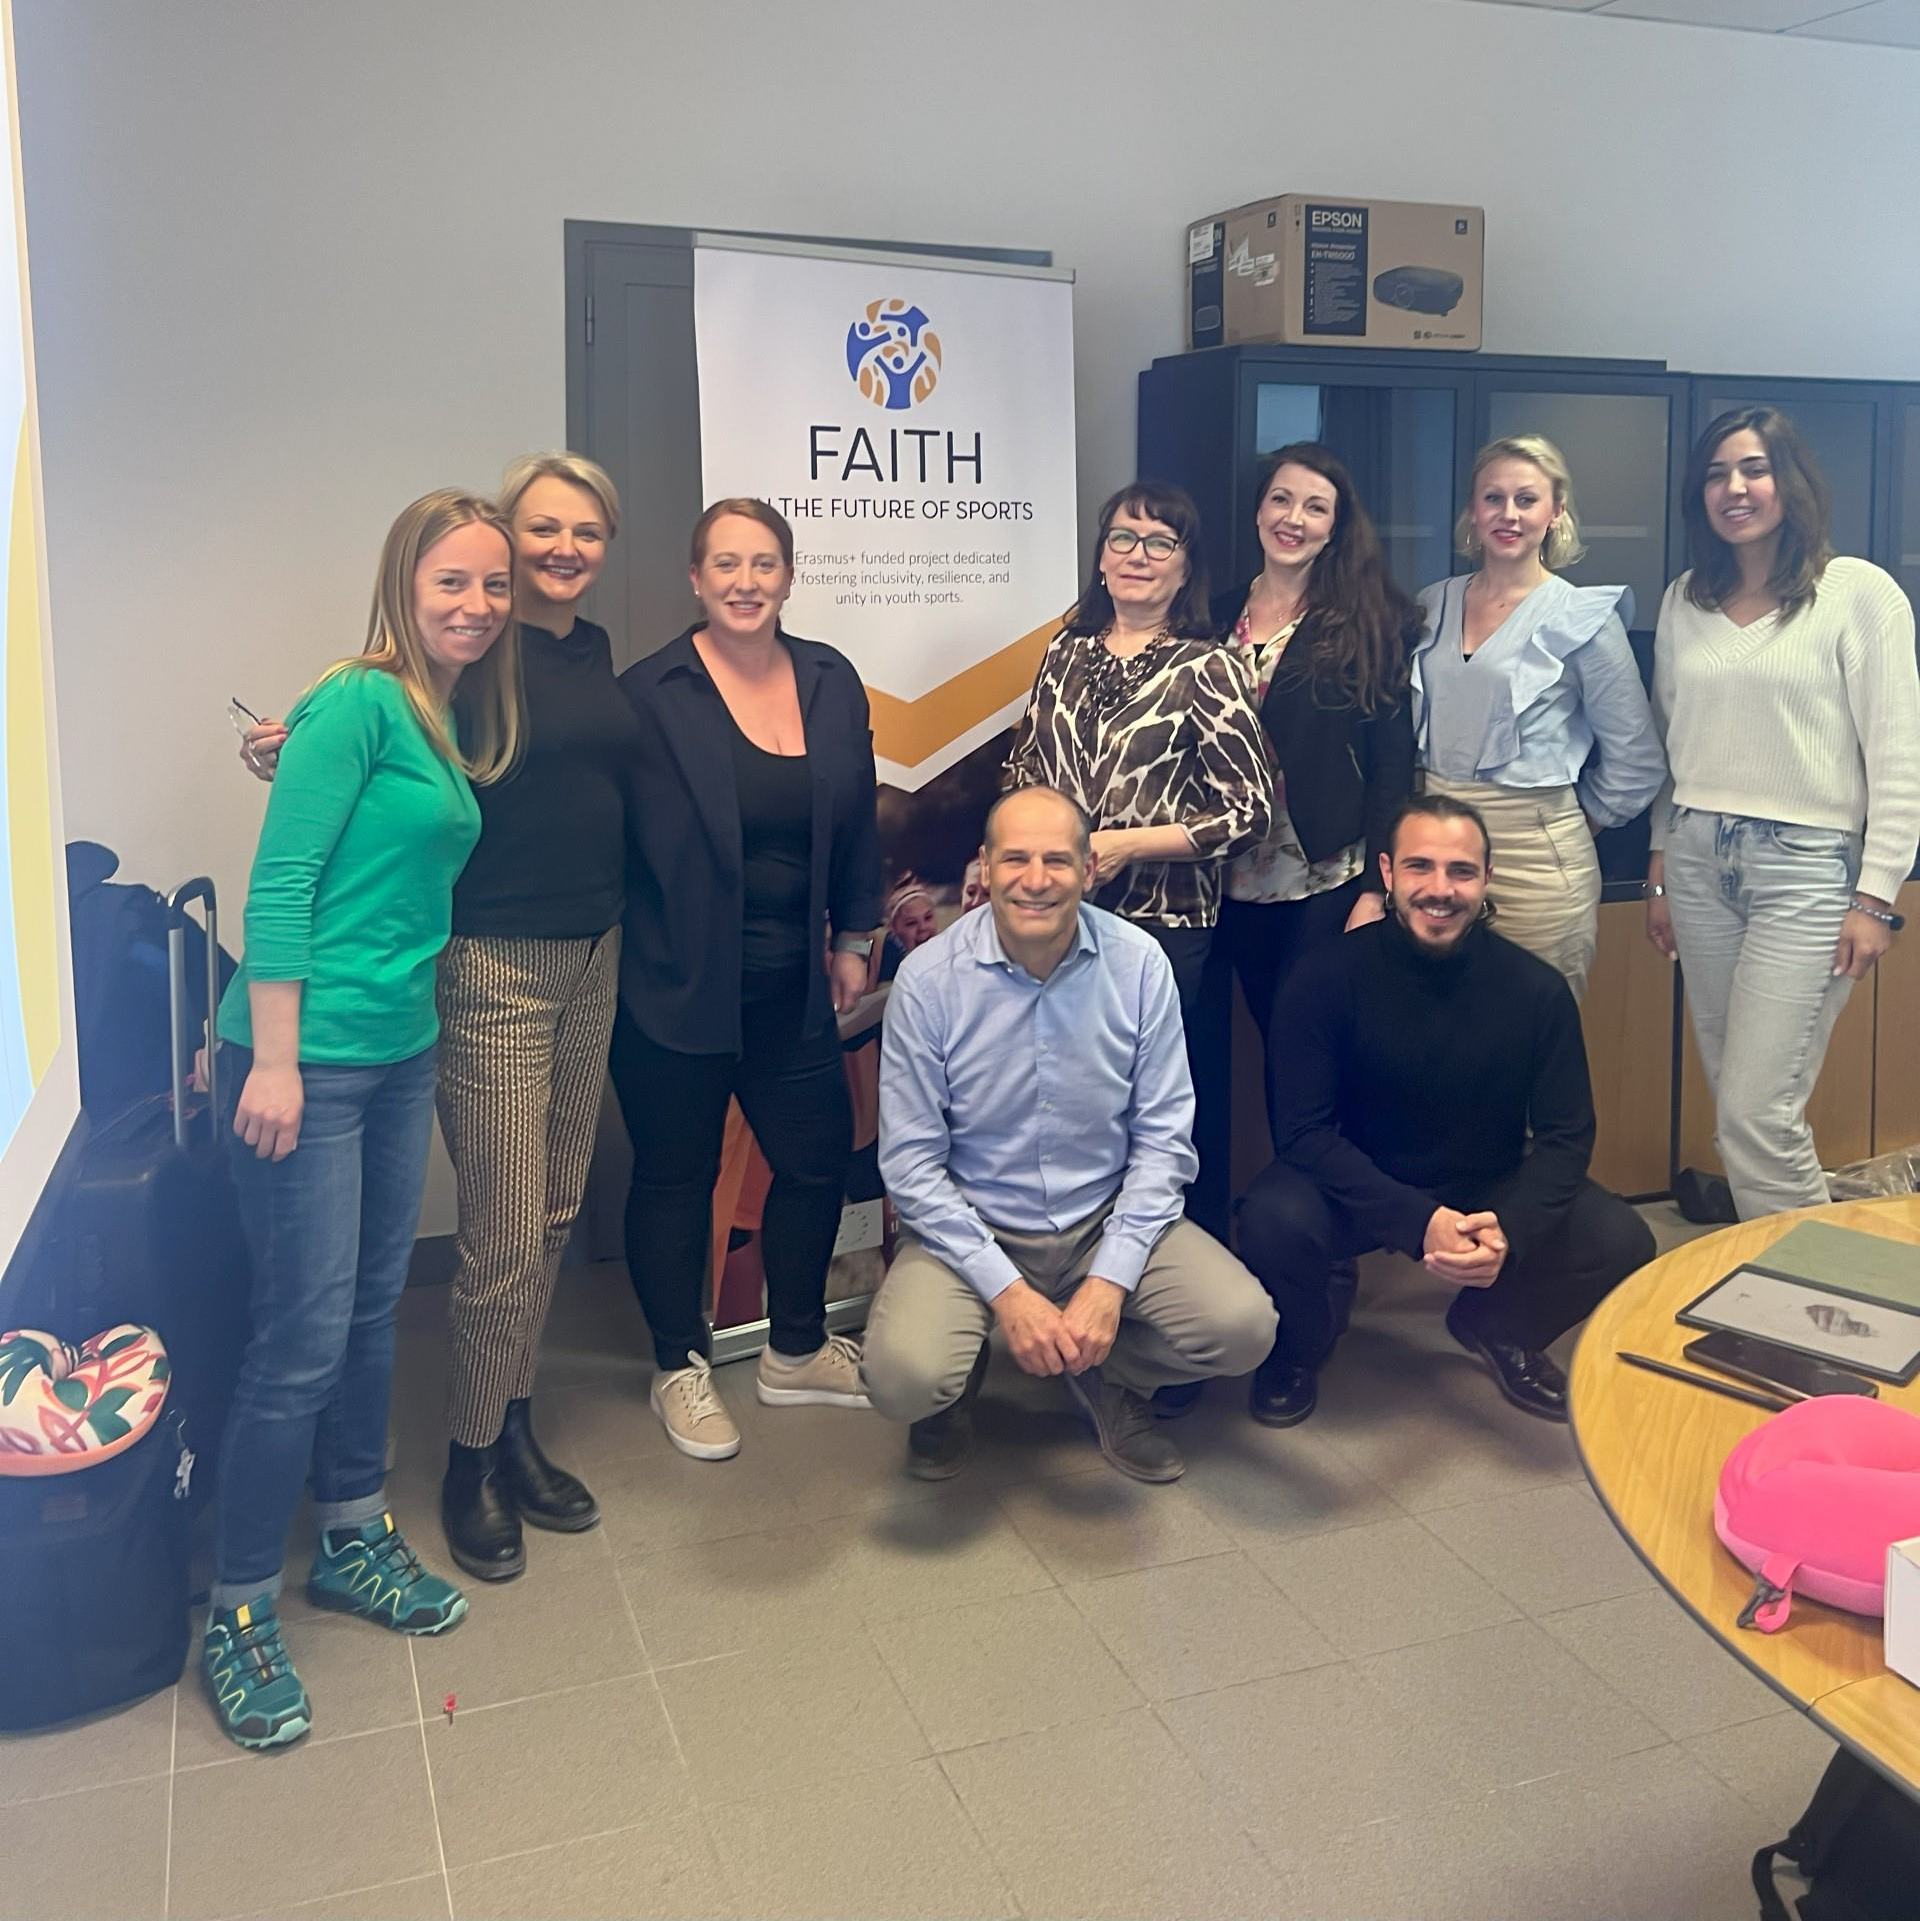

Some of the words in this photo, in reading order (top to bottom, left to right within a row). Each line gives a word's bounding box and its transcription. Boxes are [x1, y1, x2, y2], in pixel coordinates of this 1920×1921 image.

[1312, 210, 1362, 228] EPSON
[809, 425, 981, 485] FAITH
[778, 497, 823, 518] THE
[831, 498, 915, 519] FUTURE
[922, 500, 950, 520] OF
[956, 501, 1034, 521] SPORTS
[795, 551, 856, 566] Erasmus+
[861, 550, 905, 566] funded
[909, 551, 950, 571] project
[953, 550, 1011, 565] dedicated
[801, 570, 857, 588] fostering
[861, 570, 925, 587] inclusivity,
[928, 570, 986, 586] resilience,
[989, 570, 1010, 585] and
[835, 590, 867, 608] unity
[870, 591, 881, 604] in
[885, 590, 921, 608] youth
[924, 591, 964, 607] sports.
